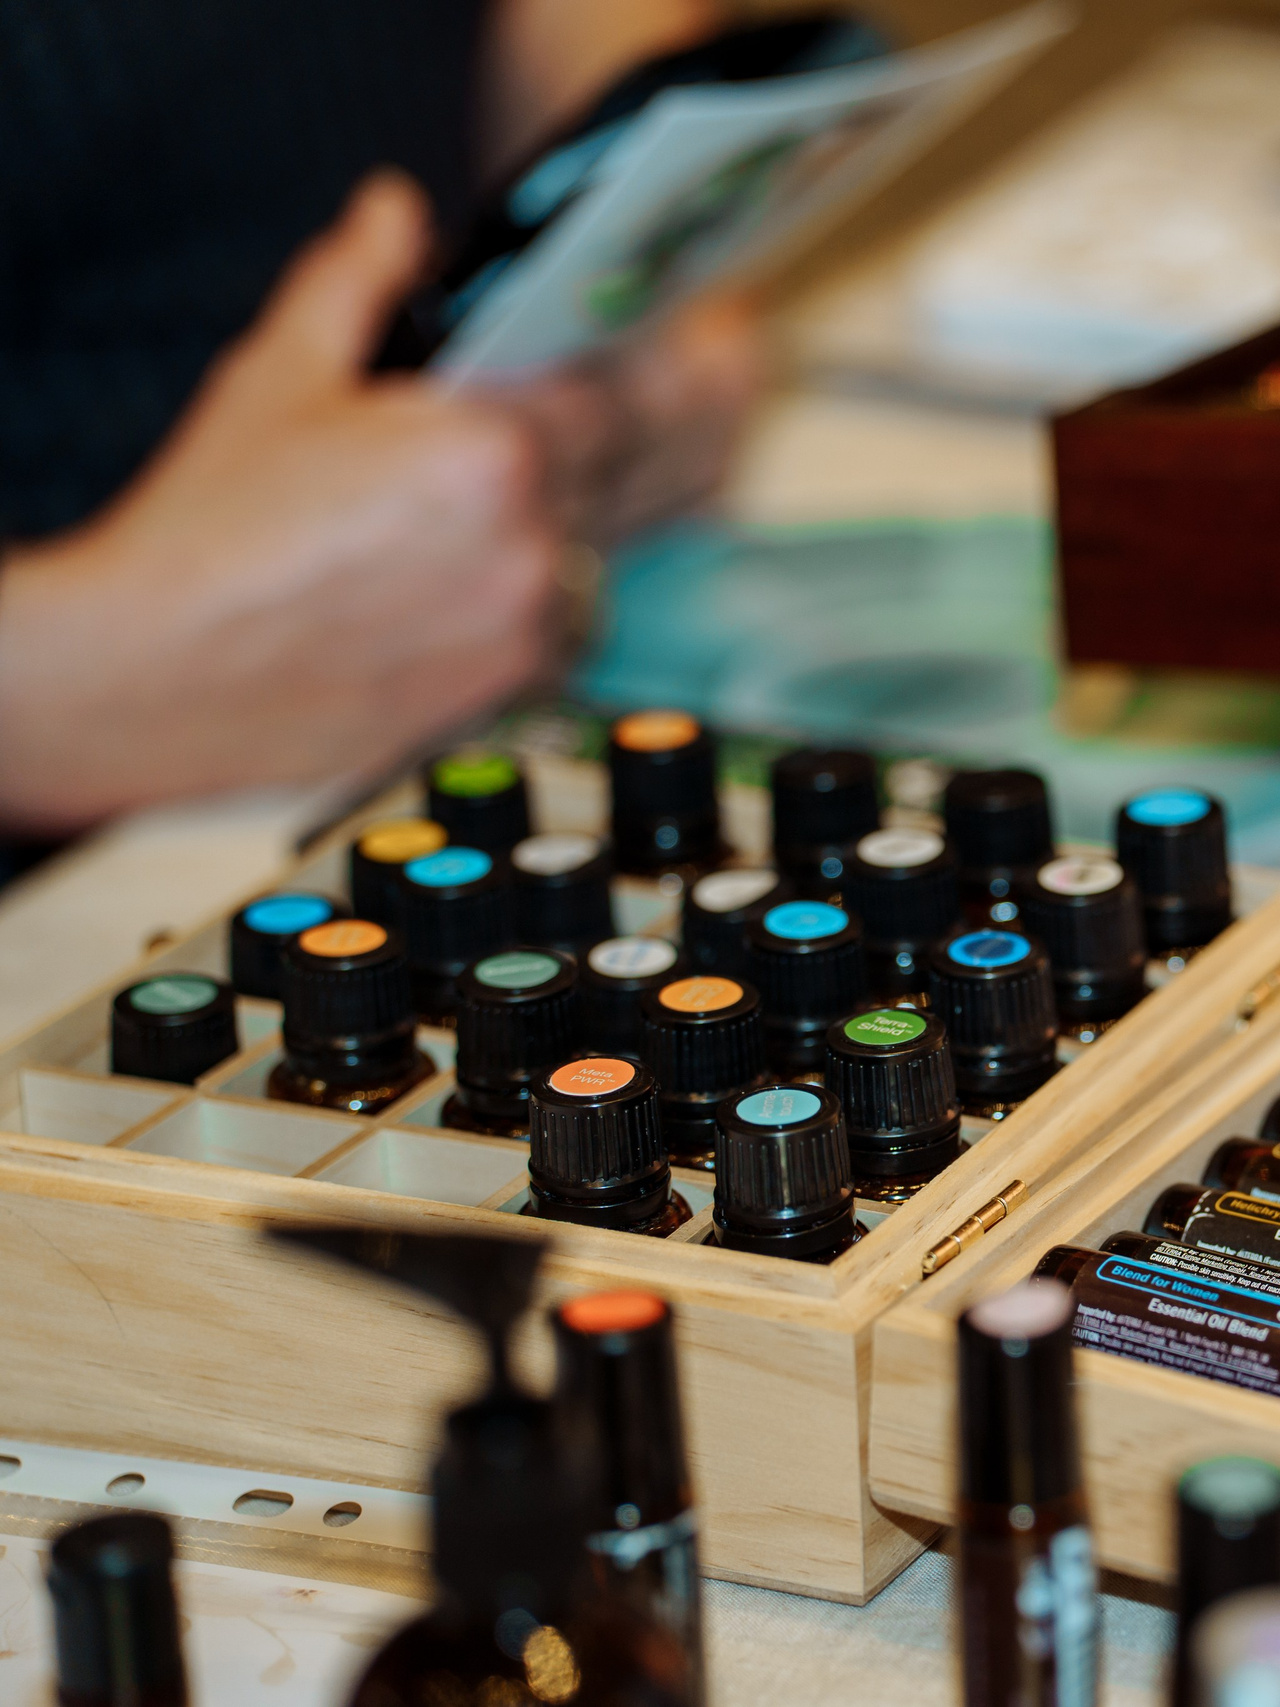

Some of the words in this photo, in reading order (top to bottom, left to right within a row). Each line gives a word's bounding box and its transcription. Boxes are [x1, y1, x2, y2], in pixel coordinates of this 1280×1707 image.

[578, 1068, 614, 1078] Meta
[1111, 1264, 1151, 1284] Blend
[1151, 1273, 1171, 1289] for
[1172, 1279, 1220, 1302] Women
[1150, 1252, 1177, 1265] CAUTION:
[1178, 1260, 1199, 1271] Possible
[1199, 1266, 1210, 1274] skin
[1211, 1269, 1236, 1282] sensitivity.
[1237, 1276, 1250, 1286] Keep
[1148, 1297, 1207, 1326] Essential
[1208, 1312, 1226, 1330] Oil
[1227, 1318, 1270, 1342] Blend
